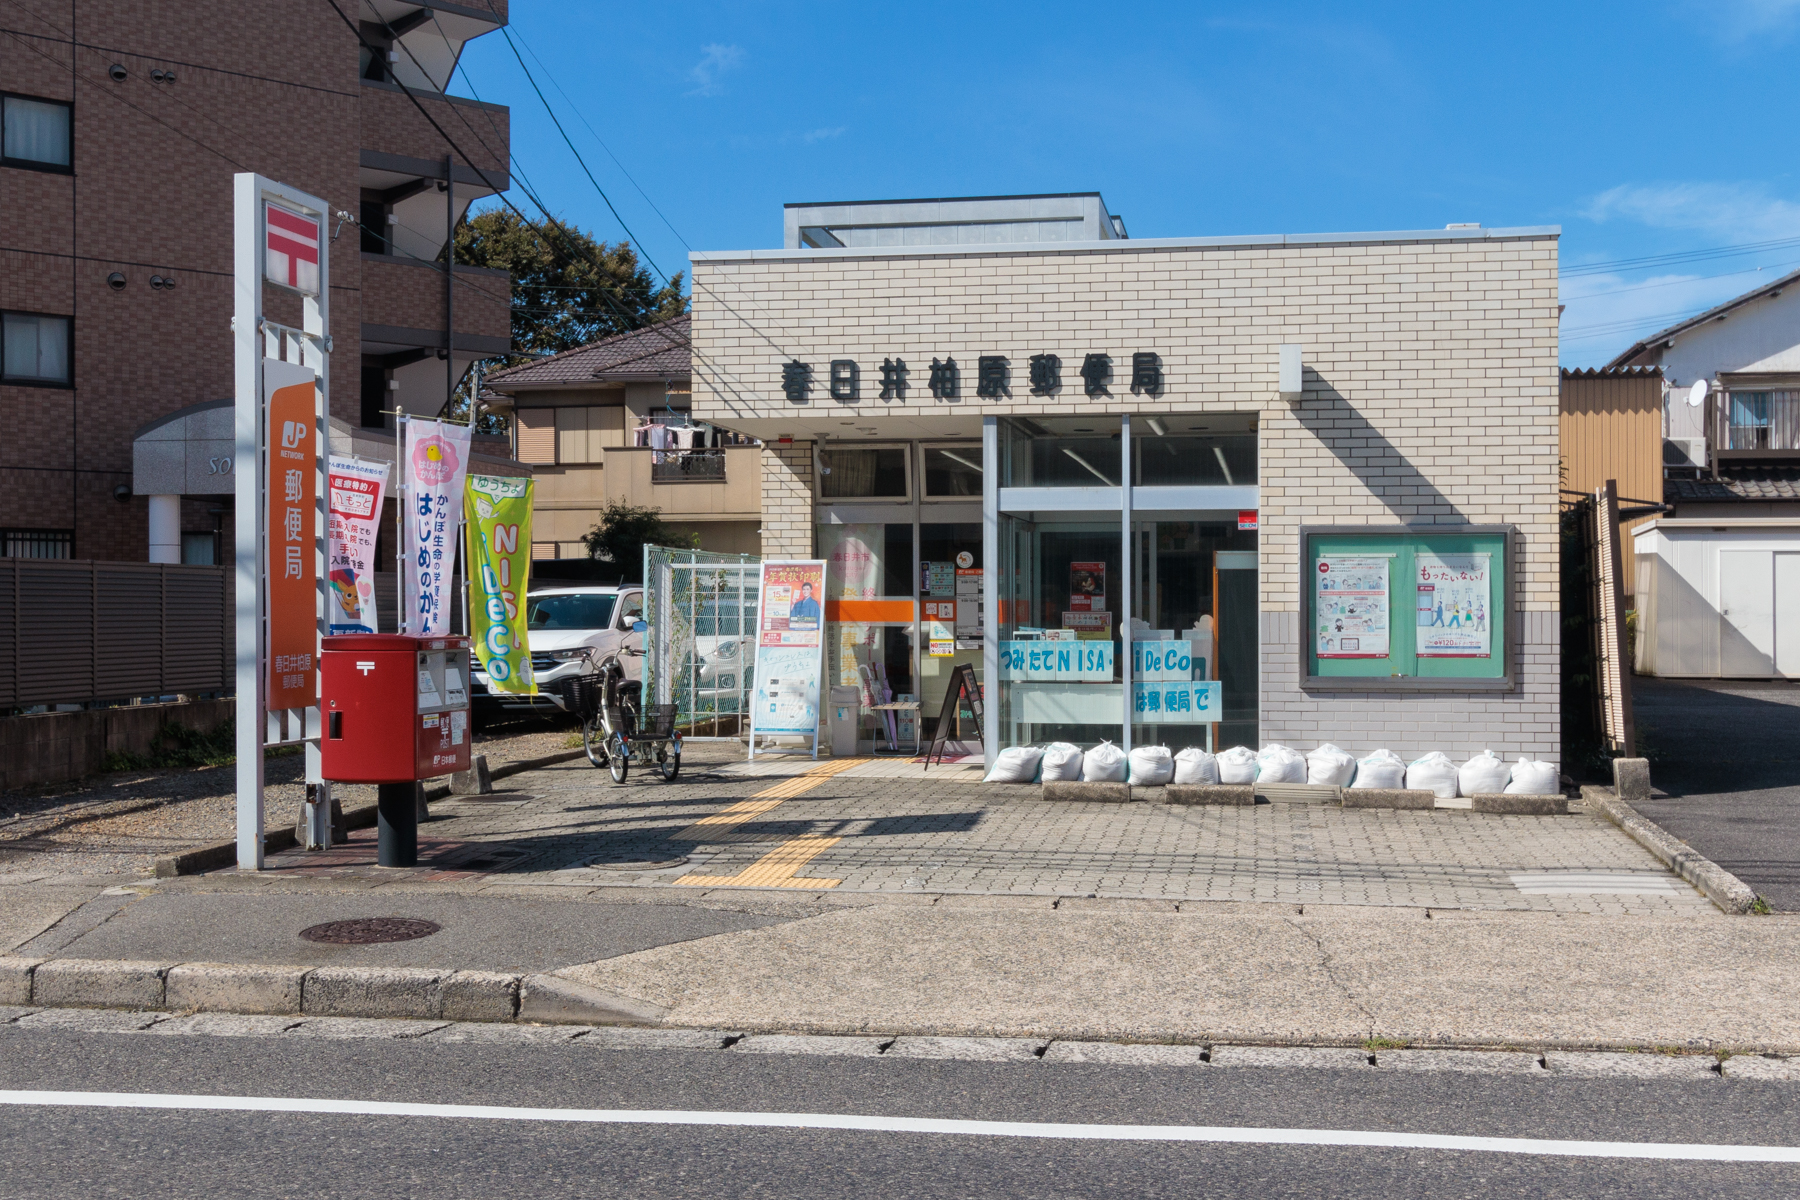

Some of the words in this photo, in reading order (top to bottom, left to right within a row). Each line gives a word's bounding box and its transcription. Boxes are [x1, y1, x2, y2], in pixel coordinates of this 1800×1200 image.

[781, 352, 1161, 401] 春日井柏原郵便局
[280, 450, 305, 460] NETWORK
[418, 460, 449, 472] はじめの
[334, 478, 368, 492] 医療特約
[477, 475, 520, 494] ゆうちょ
[345, 495, 371, 509] もっと
[284, 469, 303, 580] 郵便局
[833, 552, 870, 563] 春日井市
[768, 571, 821, 583] 年賀状印刷
[275, 653, 312, 673] 春日井柏原
[1135, 649, 1191, 672] iDeCo
[282, 674, 305, 690] 郵便局
[1135, 688, 1210, 713] は郵便局で
